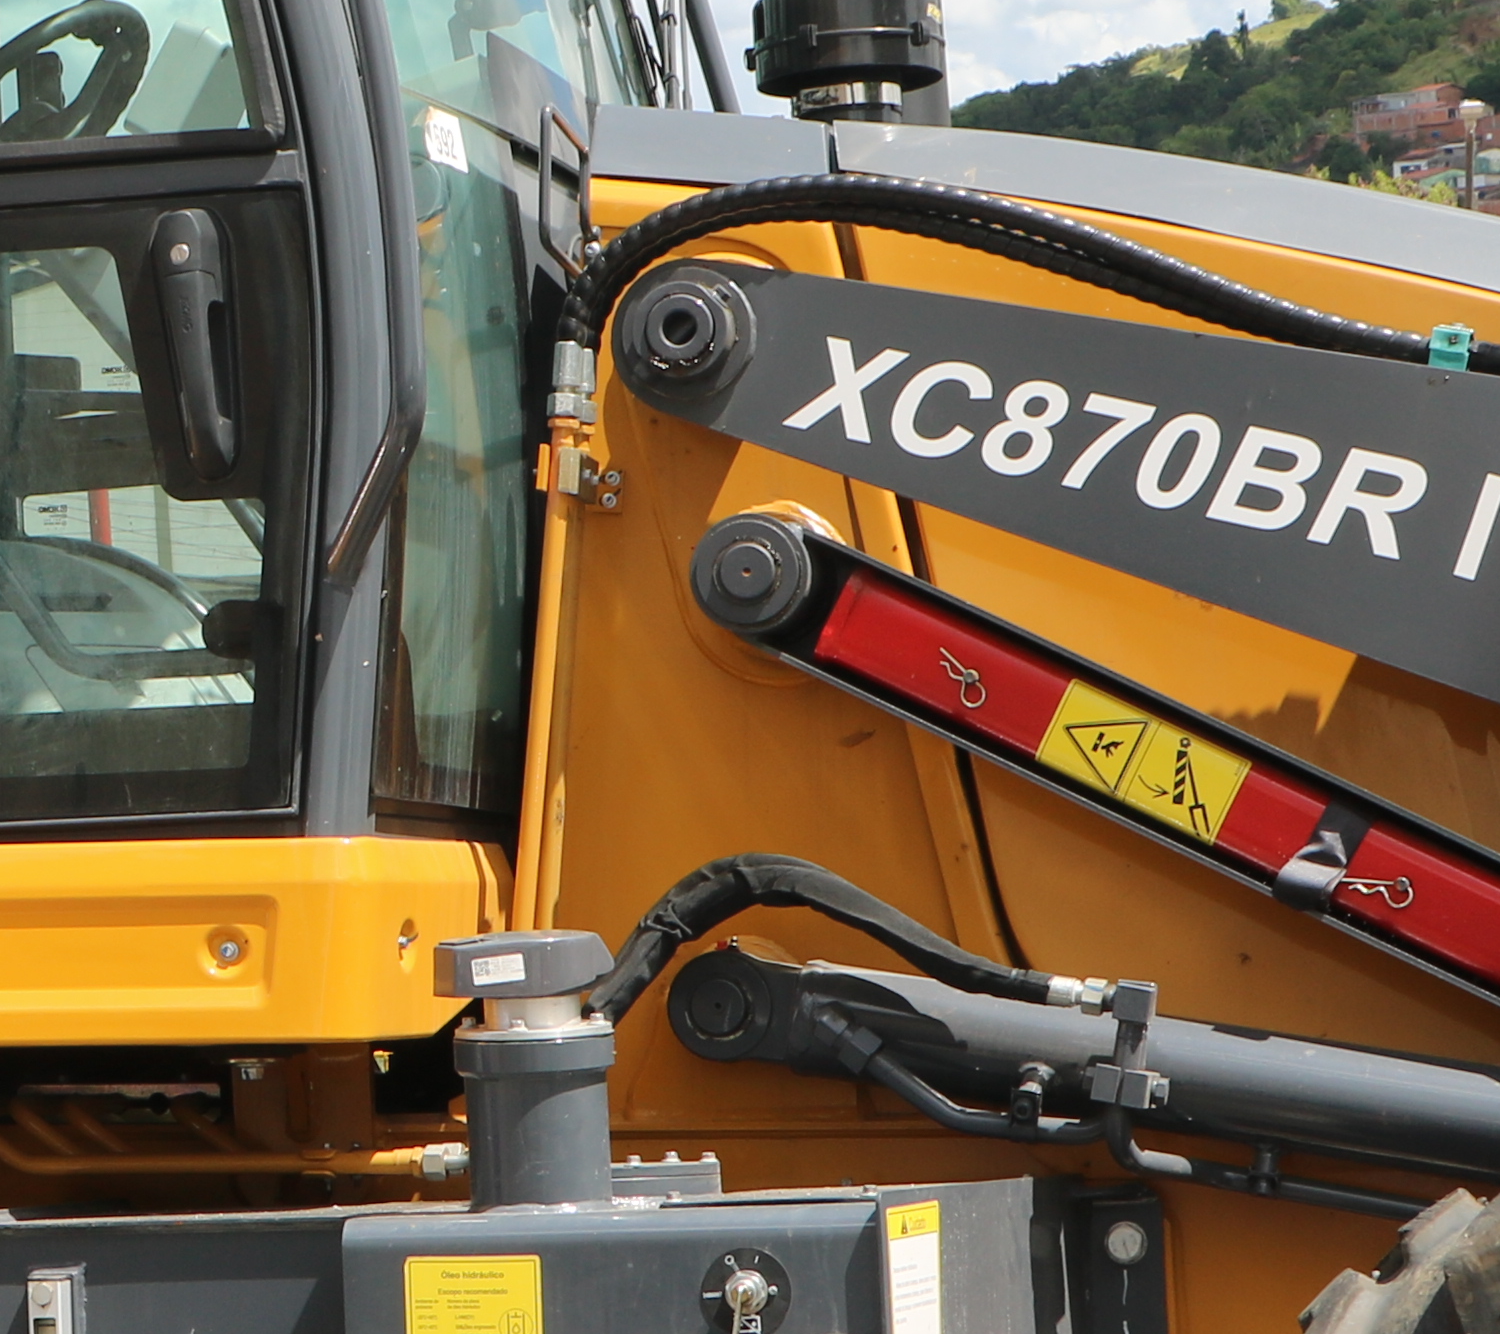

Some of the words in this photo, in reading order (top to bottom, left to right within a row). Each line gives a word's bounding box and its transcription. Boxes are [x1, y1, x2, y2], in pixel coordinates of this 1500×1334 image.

[782, 336, 1428, 560] XC870BR
[440, 1269, 461, 1279] Óleo
[462, 1269, 505, 1280] hidráulico
[438, 1288, 462, 1298] Escopo
[463, 1288, 508, 1296] recomendado
